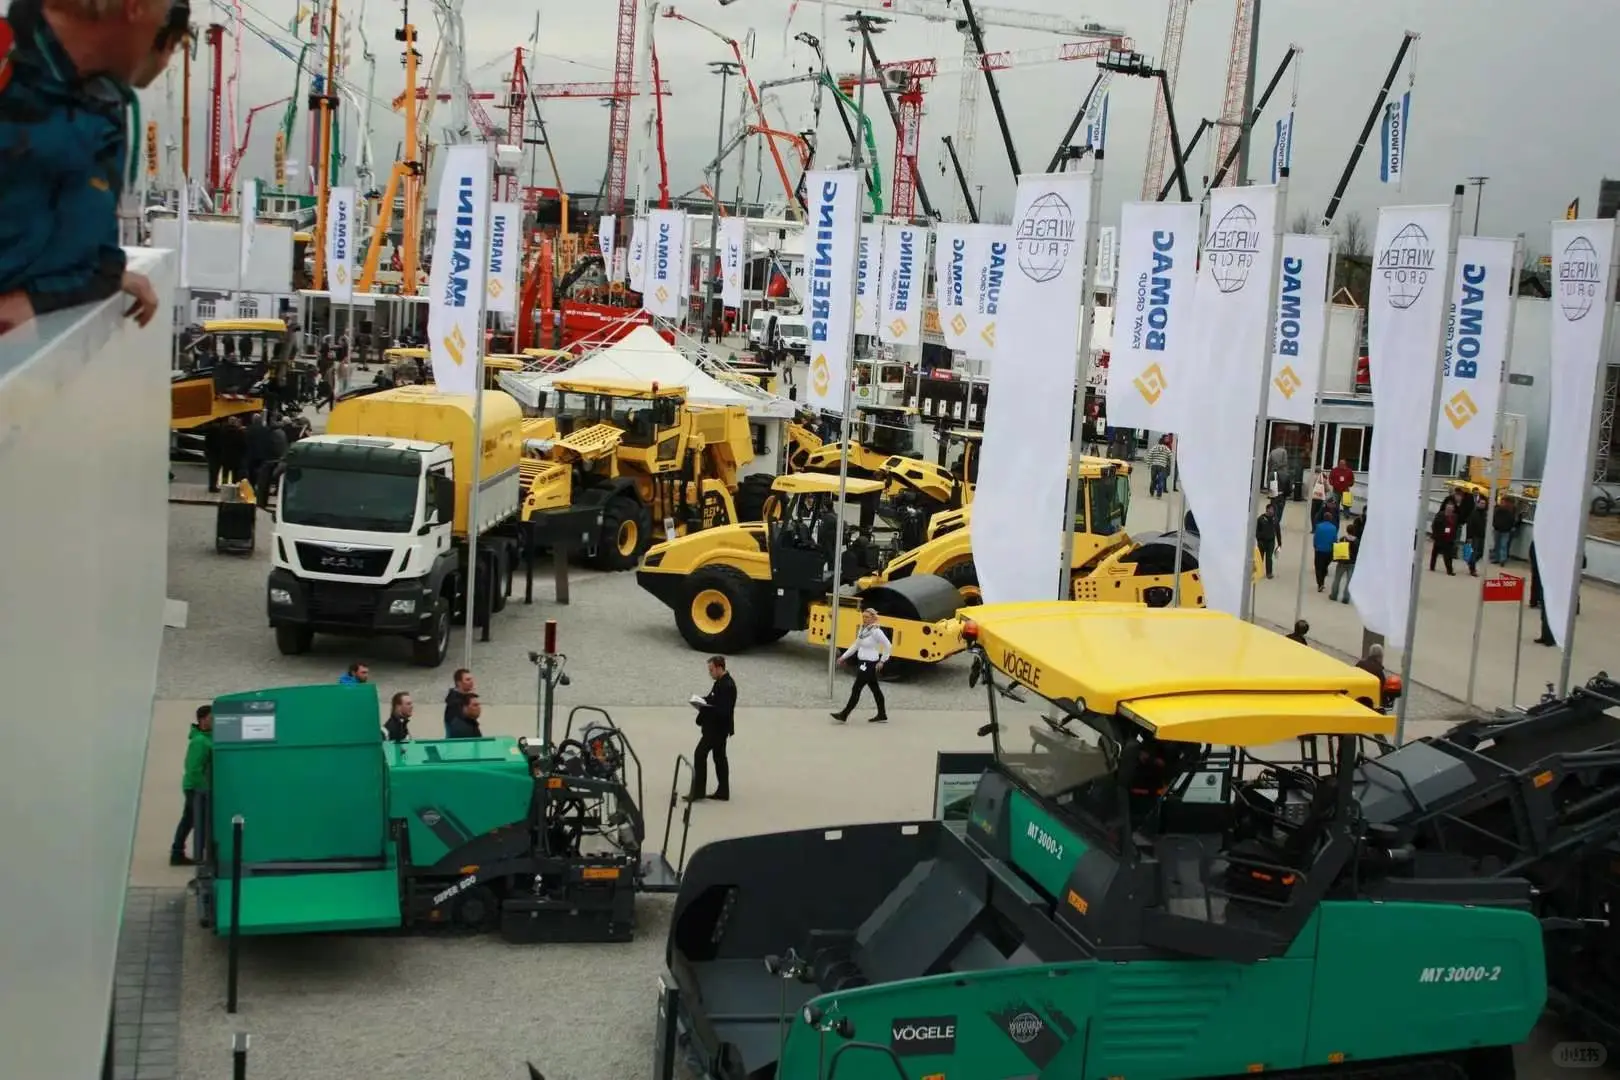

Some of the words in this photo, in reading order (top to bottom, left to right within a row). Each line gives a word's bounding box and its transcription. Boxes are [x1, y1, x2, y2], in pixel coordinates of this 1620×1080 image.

[1003, 649, 1042, 688] VÖGELE
[1027, 821, 1039, 844] MT
[1038, 830, 1064, 861] 3000-2
[1419, 967, 1445, 983] MT
[1444, 966, 1502, 982] 3000-2
[892, 1024, 955, 1041] VÖGELE
